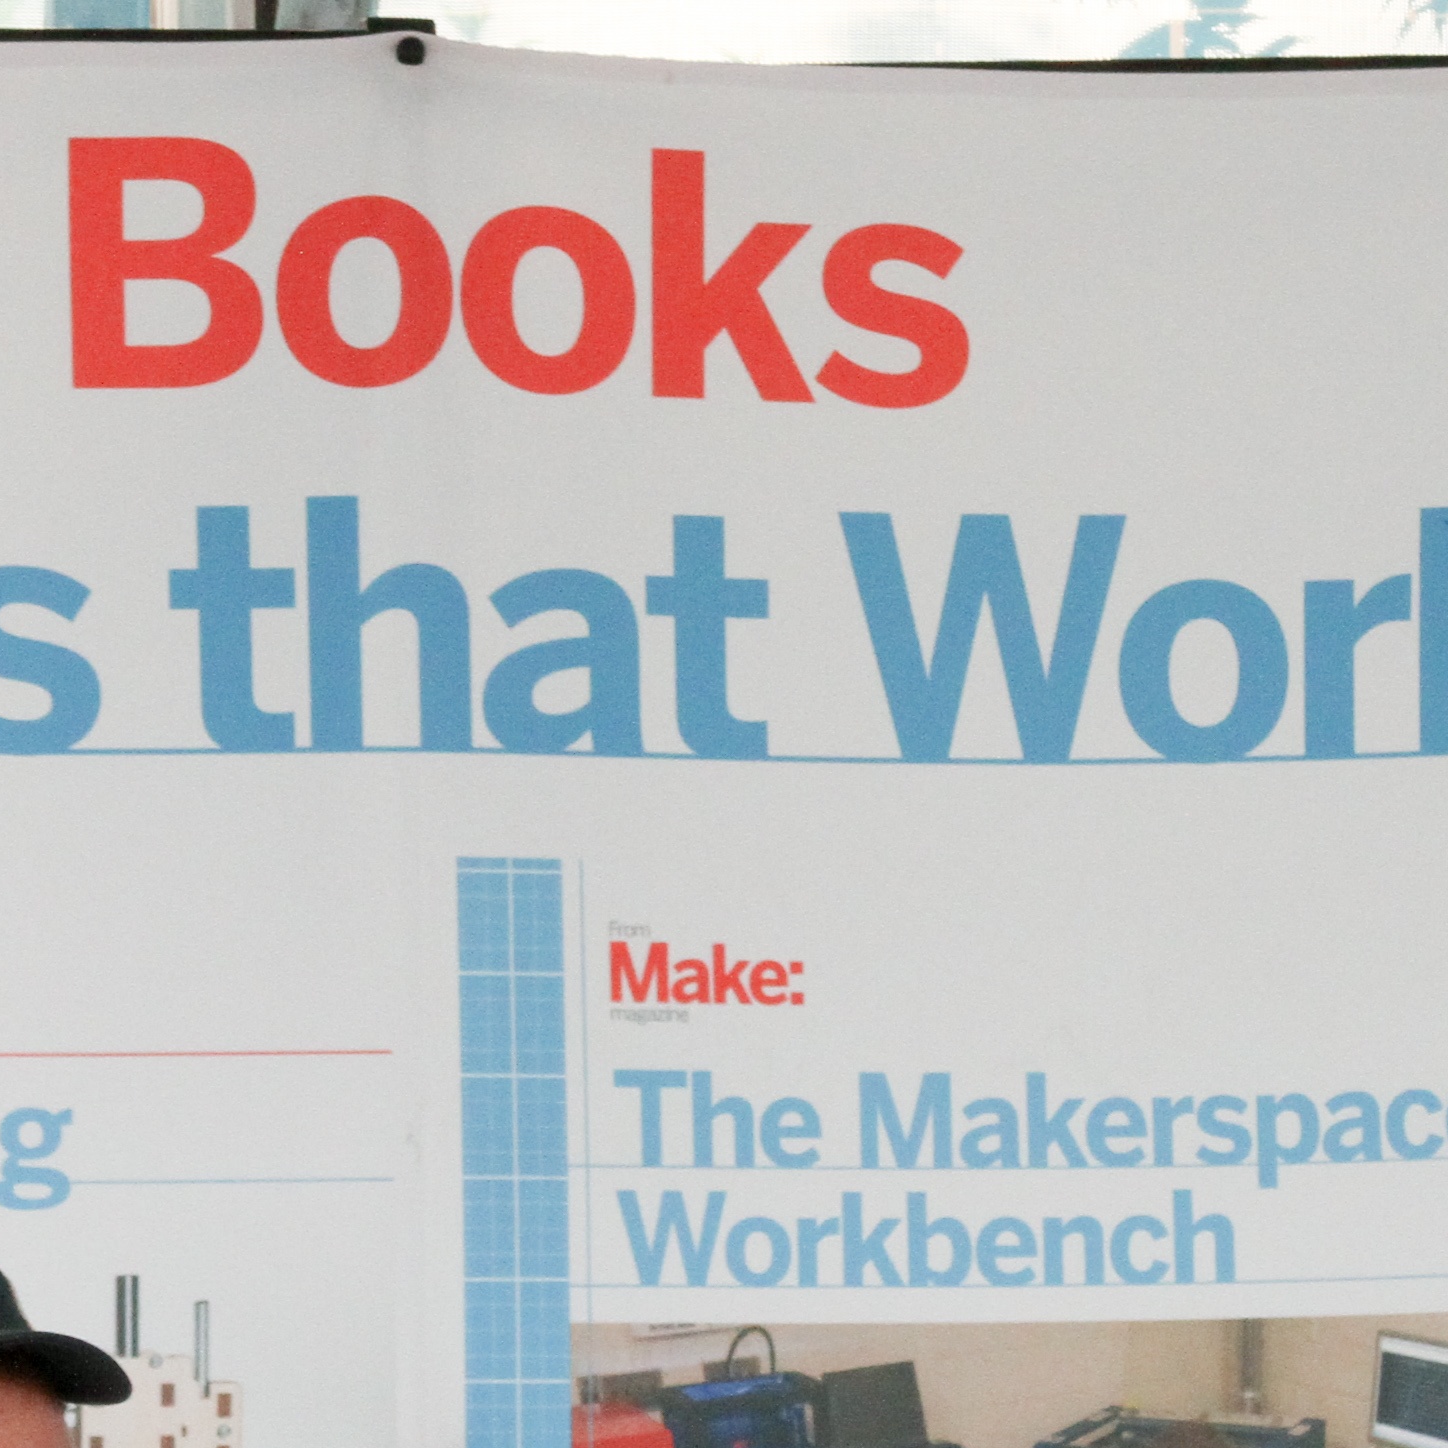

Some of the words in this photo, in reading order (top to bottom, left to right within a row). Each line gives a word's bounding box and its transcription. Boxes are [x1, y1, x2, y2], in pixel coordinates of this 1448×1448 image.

[68, 136, 970, 409] Books
[169, 495, 769, 758] that
[609, 941, 805, 1006] Make:
[614, 1068, 822, 1170] The
[616, 1188, 1237, 1287] Workbench
